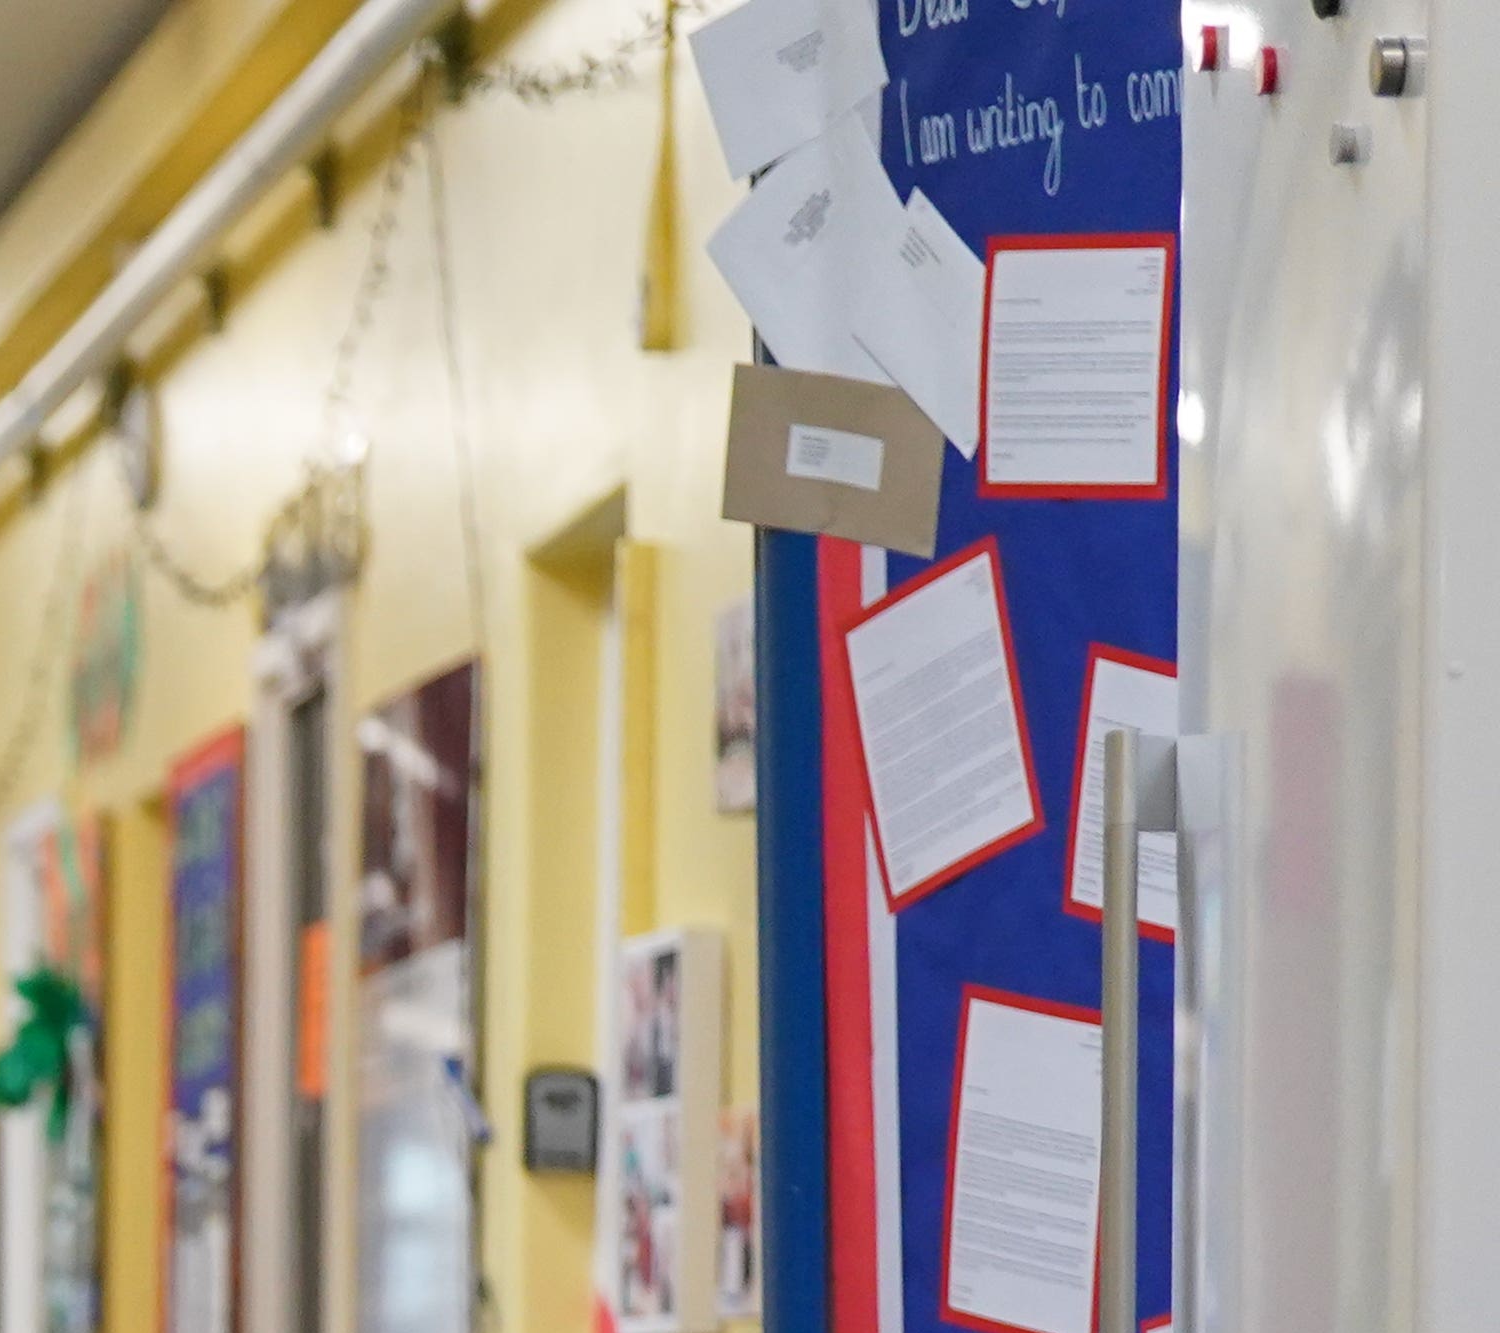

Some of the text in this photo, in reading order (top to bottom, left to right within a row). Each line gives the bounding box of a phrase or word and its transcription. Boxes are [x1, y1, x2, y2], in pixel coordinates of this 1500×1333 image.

[920, 112, 956, 165] am
[966, 72, 1064, 197] writing
[1074, 52, 1107, 129] to
